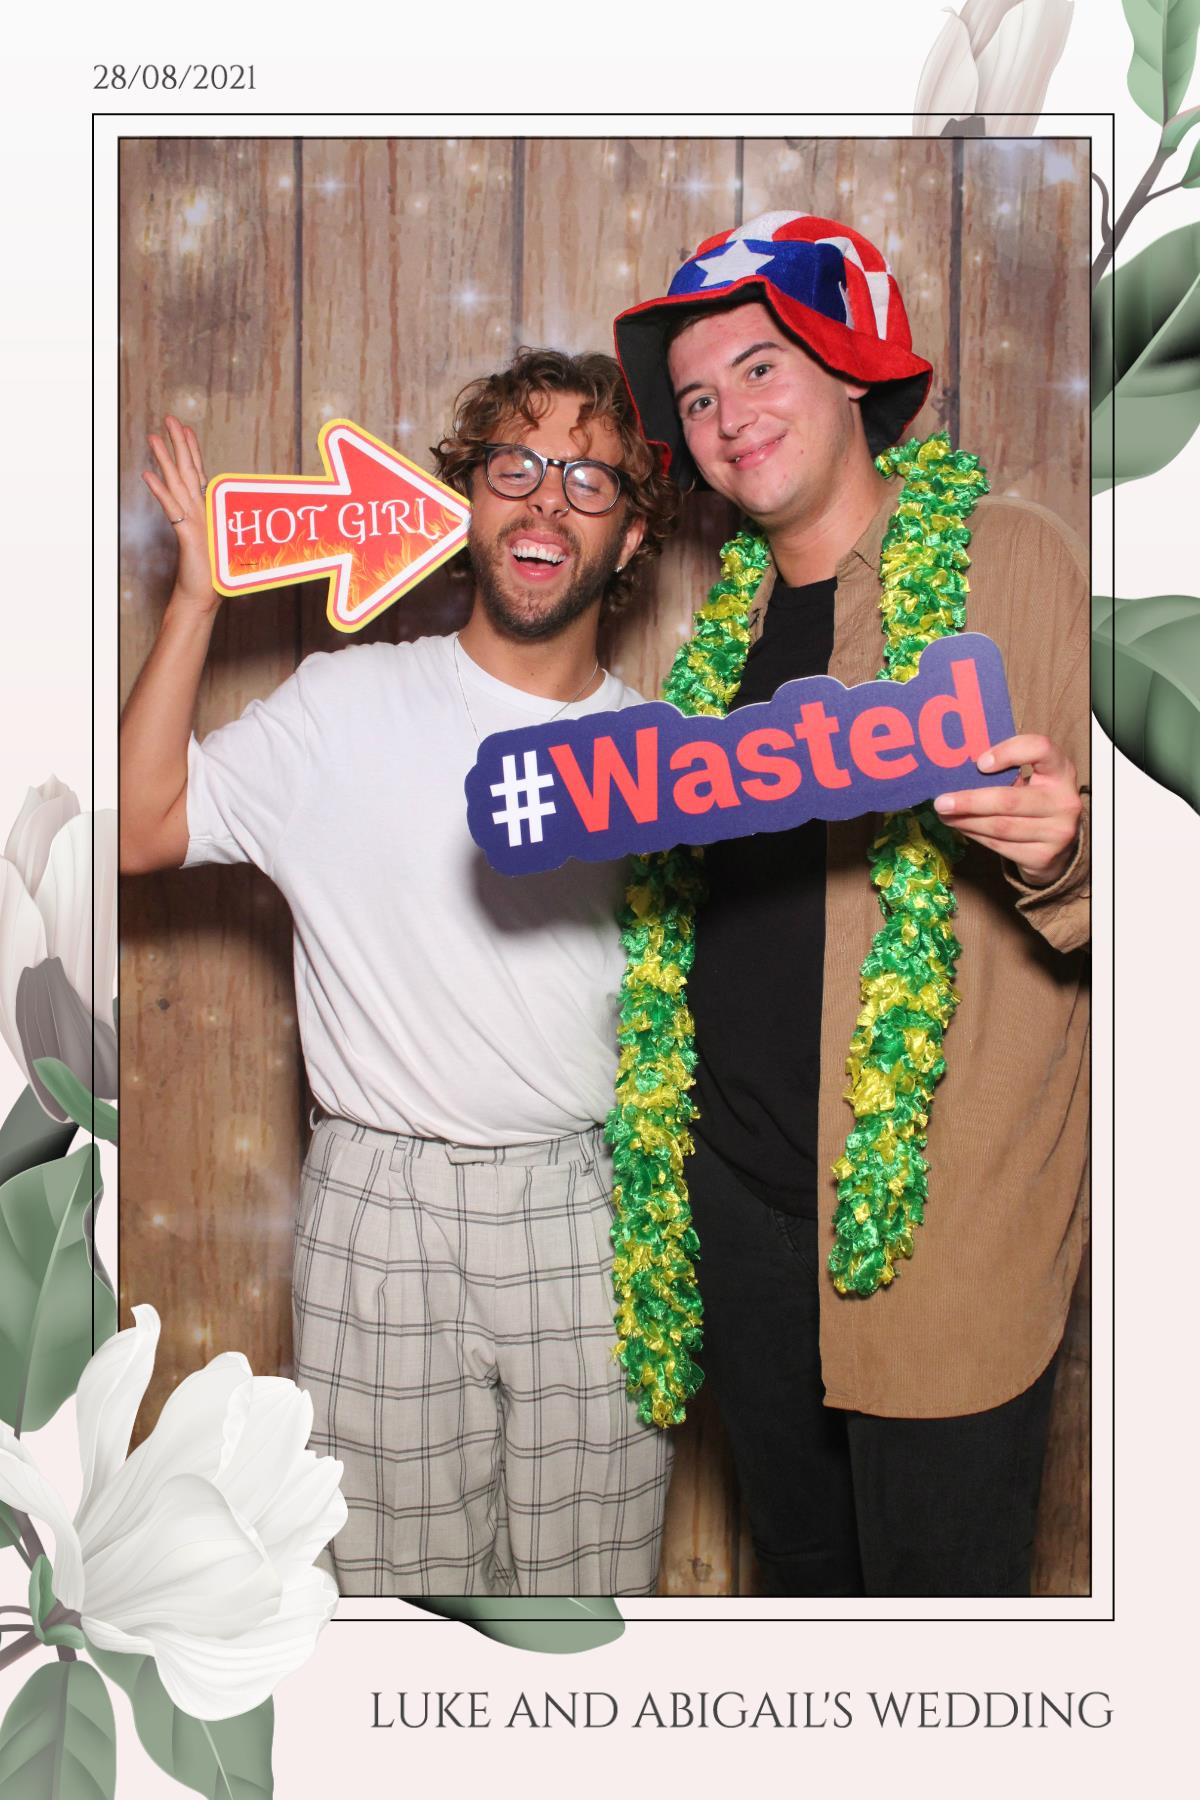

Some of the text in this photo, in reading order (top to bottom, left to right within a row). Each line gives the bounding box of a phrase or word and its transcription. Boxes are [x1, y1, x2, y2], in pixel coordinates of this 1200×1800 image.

[227, 497, 443, 546] HOT GIRL
[489, 657, 992, 848] #Wasted
